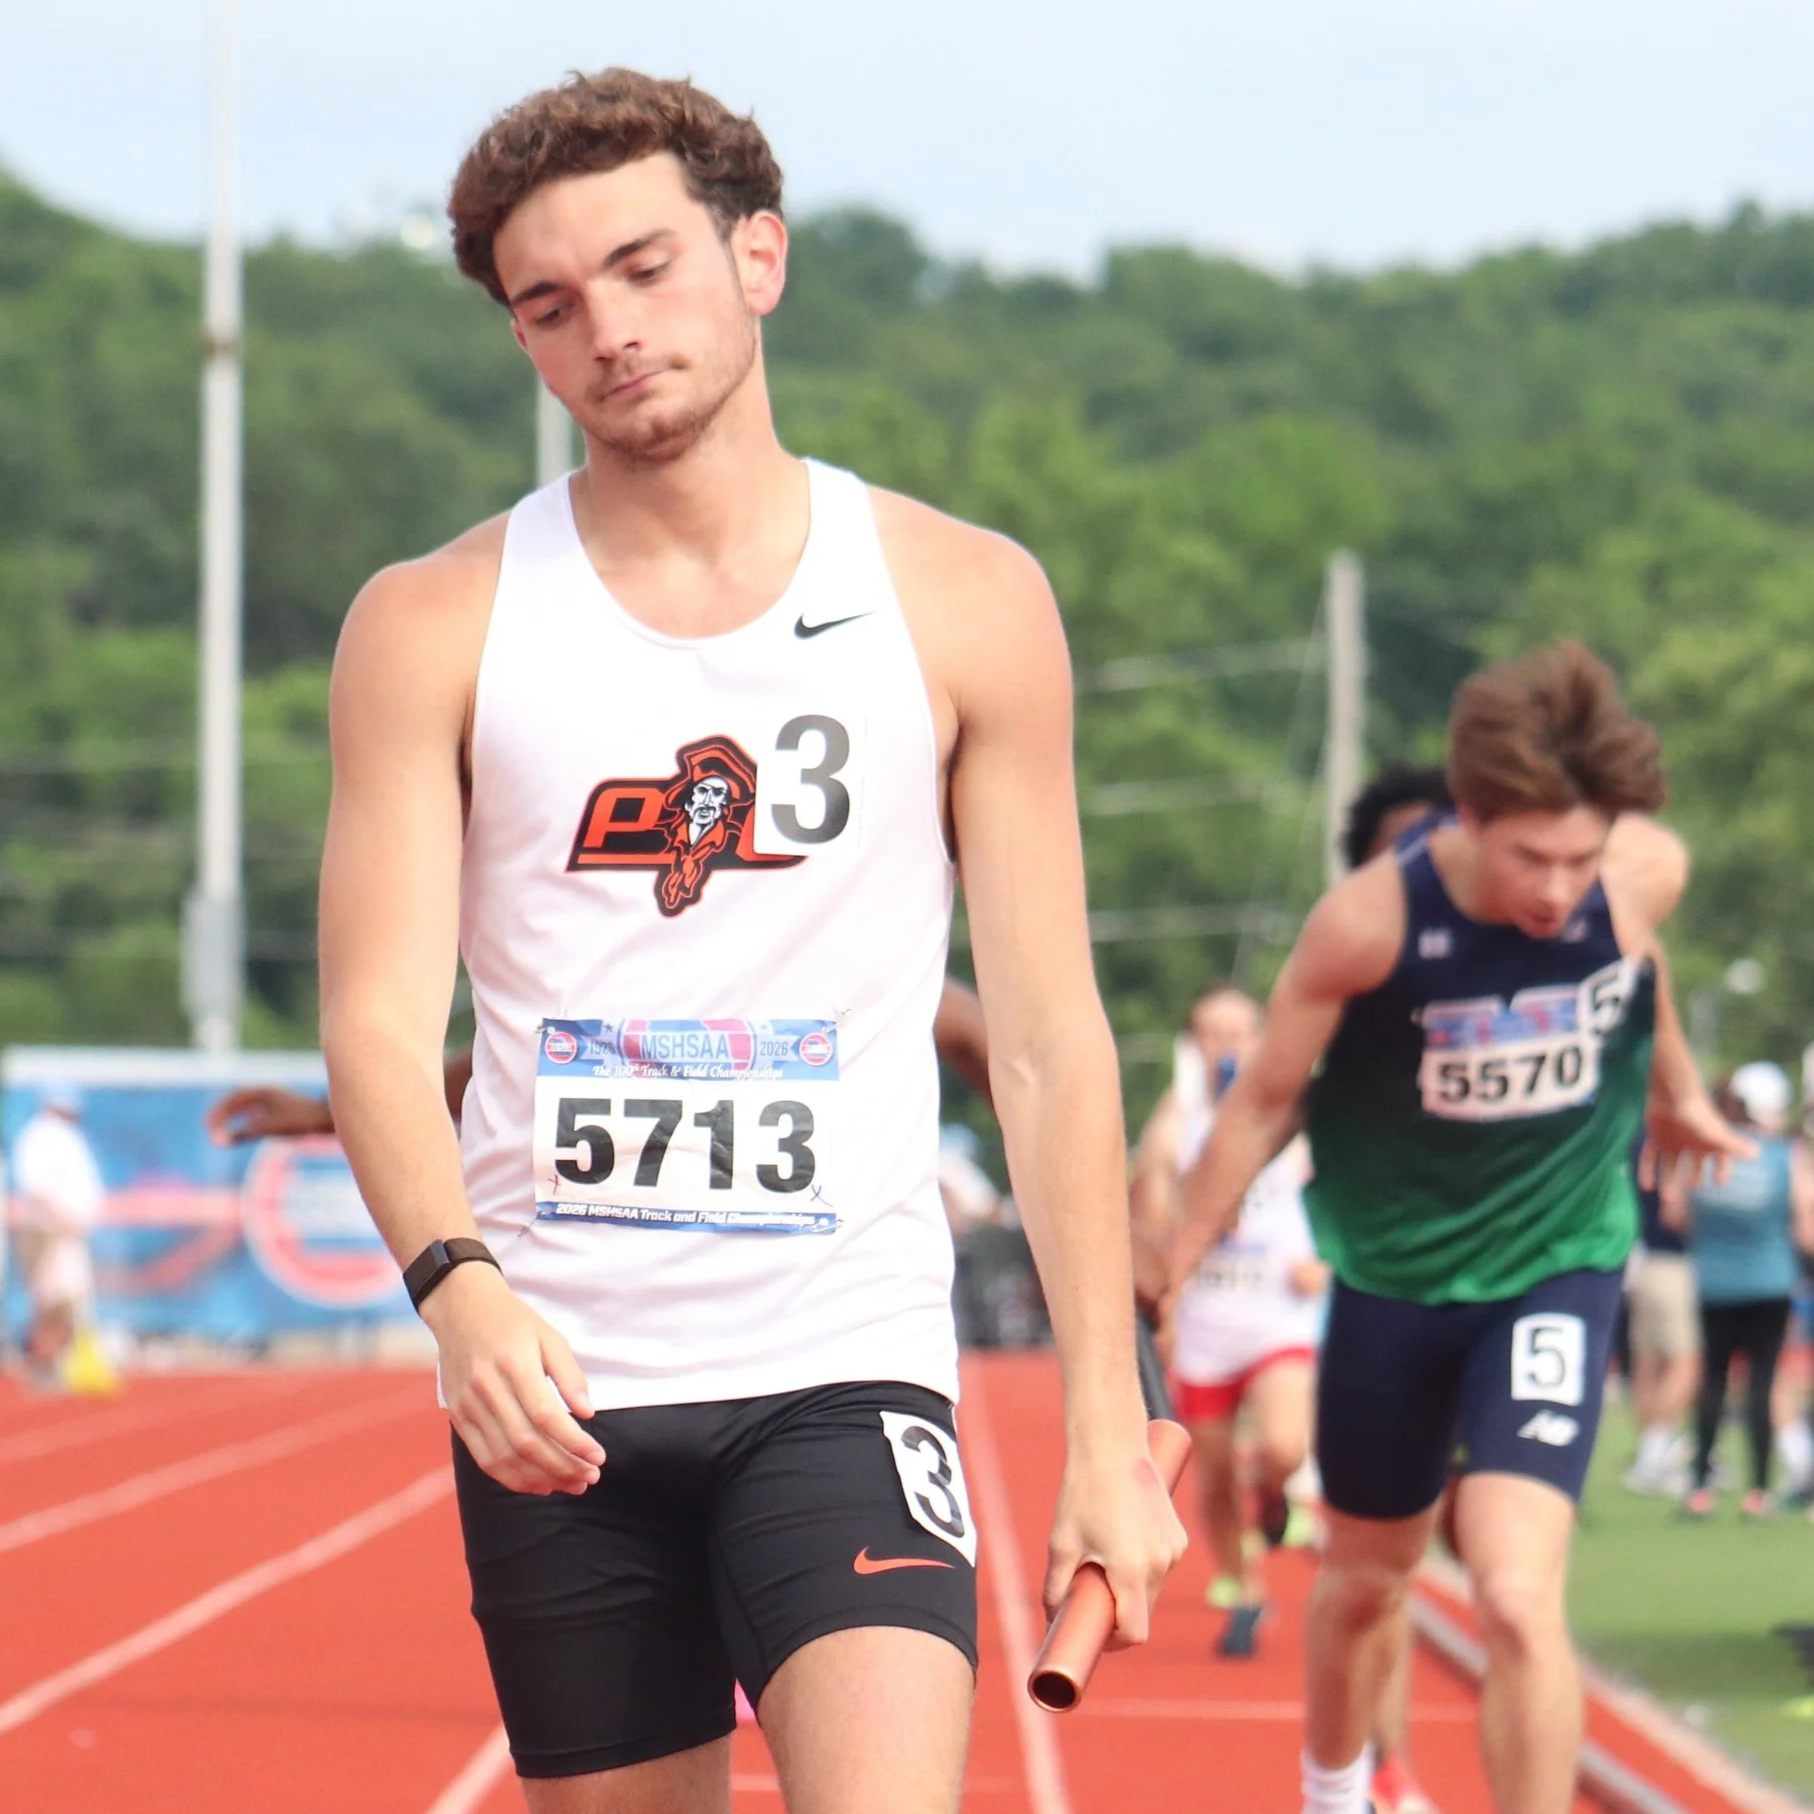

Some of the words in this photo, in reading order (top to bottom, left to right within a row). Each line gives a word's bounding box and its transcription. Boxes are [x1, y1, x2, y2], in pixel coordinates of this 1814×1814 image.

[771, 714, 850, 845] 3
[593, 1064, 611, 1077] The
[640, 1062, 668, 1077] Track
[670, 1065, 681, 1077] &
[682, 1061, 708, 1078] Field
[640, 1033, 730, 1060] MSHSAA
[759, 1040, 789, 1057] 2026
[1437, 1045, 1583, 1103] 5570
[554, 1097, 816, 1194] 5713
[556, 1202, 587, 1216] 2026
[588, 1204, 639, 1220] MSHSAA
[640, 1207, 672, 1222] Track
[672, 1210, 697, 1223] and
[698, 1211, 726, 1224] Field
[1527, 1326, 1566, 1386] 5
[901, 1425, 965, 1539] 3
